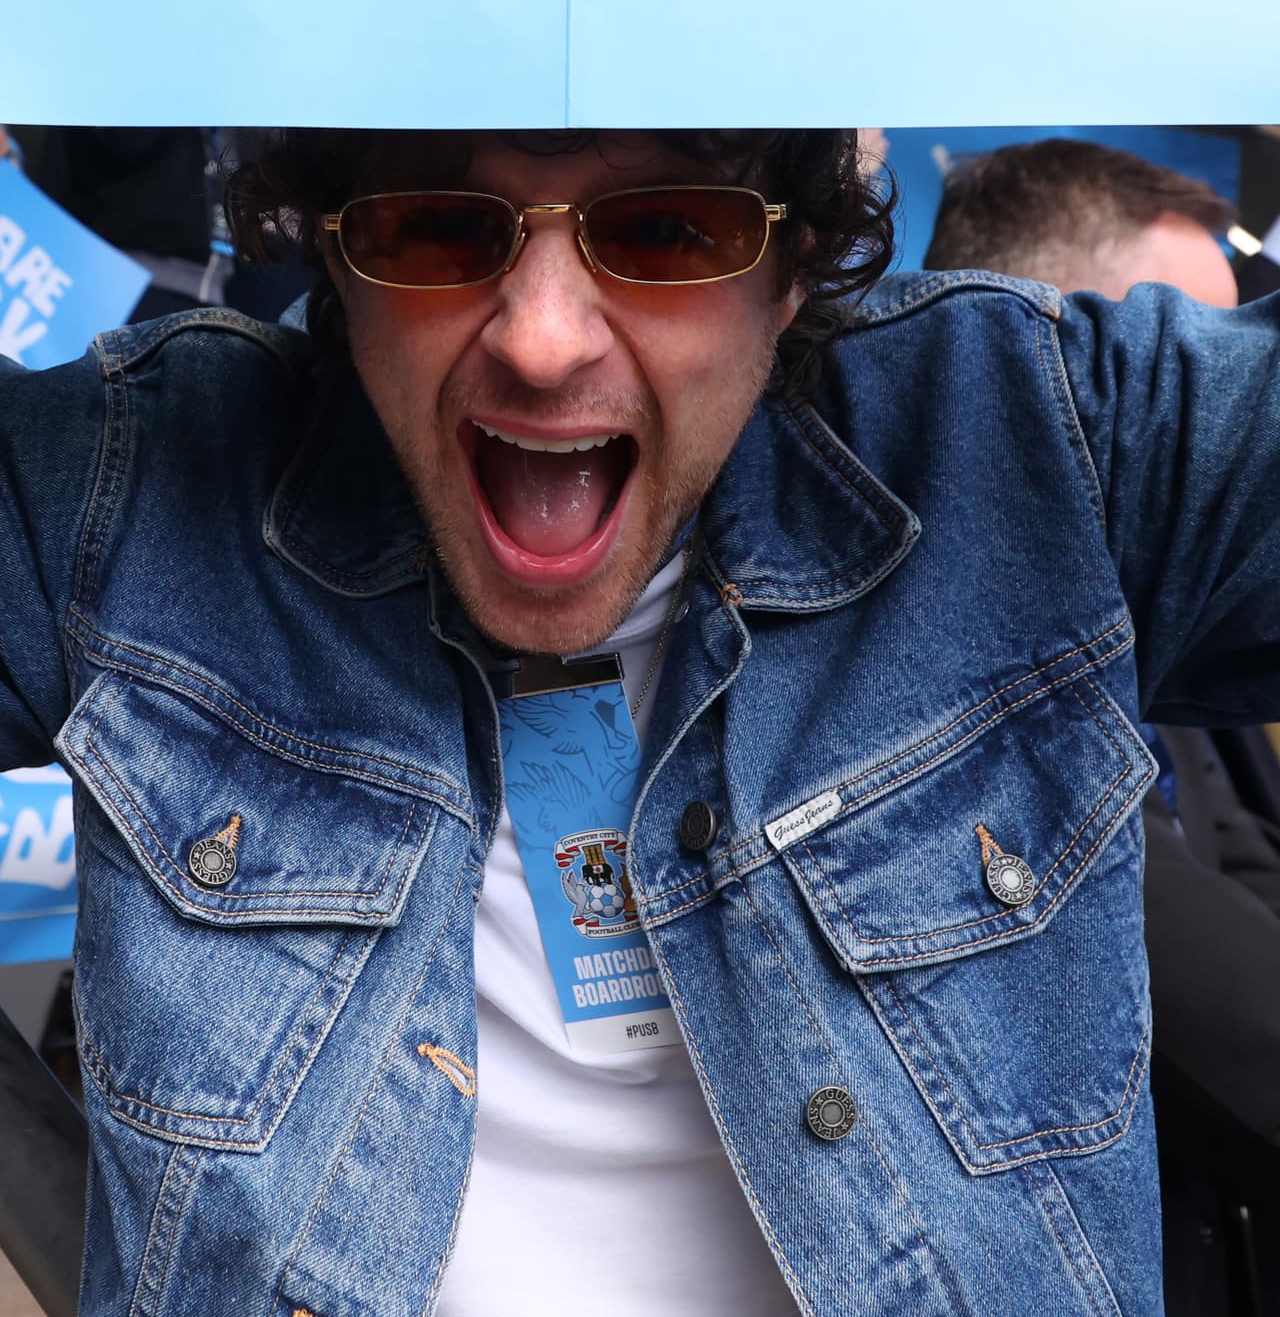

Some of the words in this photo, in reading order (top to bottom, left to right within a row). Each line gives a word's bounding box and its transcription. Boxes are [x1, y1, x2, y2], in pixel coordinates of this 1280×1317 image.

[563, 834, 598, 846] COVENTRY
[588, 925, 623, 935] FOOTBALL
[625, 1022, 659, 1038] #PUSB
